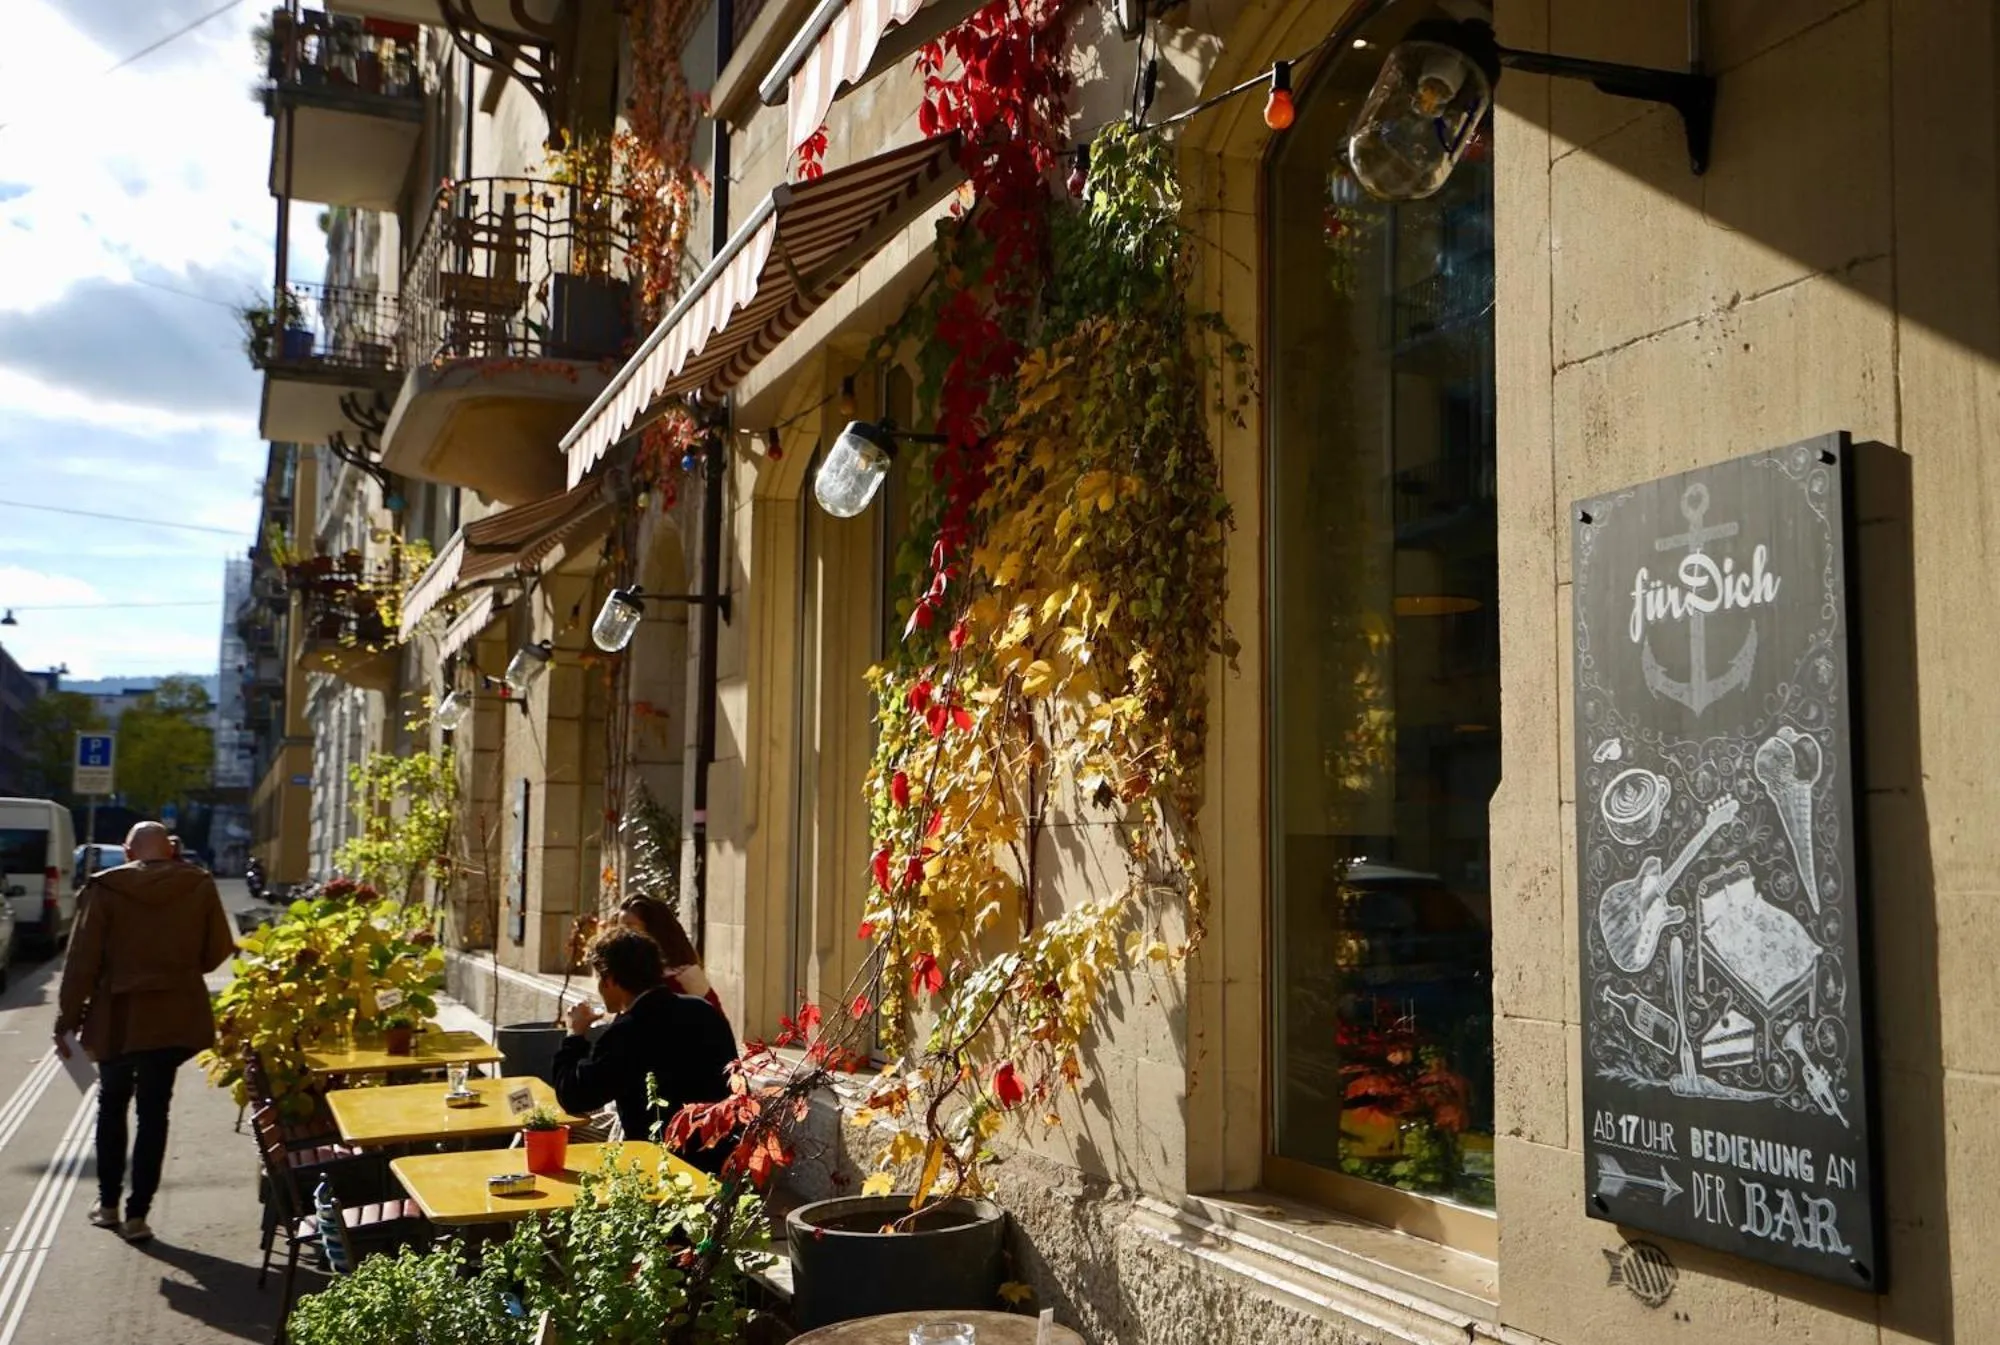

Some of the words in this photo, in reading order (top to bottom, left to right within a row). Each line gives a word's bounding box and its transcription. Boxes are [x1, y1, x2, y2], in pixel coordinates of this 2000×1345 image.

[1593, 1109, 1616, 1141] AB
[1618, 1114, 1639, 1145] 17
[1641, 1117, 1678, 1153] UHR
[1693, 1127, 1814, 1183] BEDIENUNG
[1825, 1153, 1857, 1190] AN
[1692, 1170, 1734, 1227] DER
[1739, 1178, 1852, 1255] BAR
